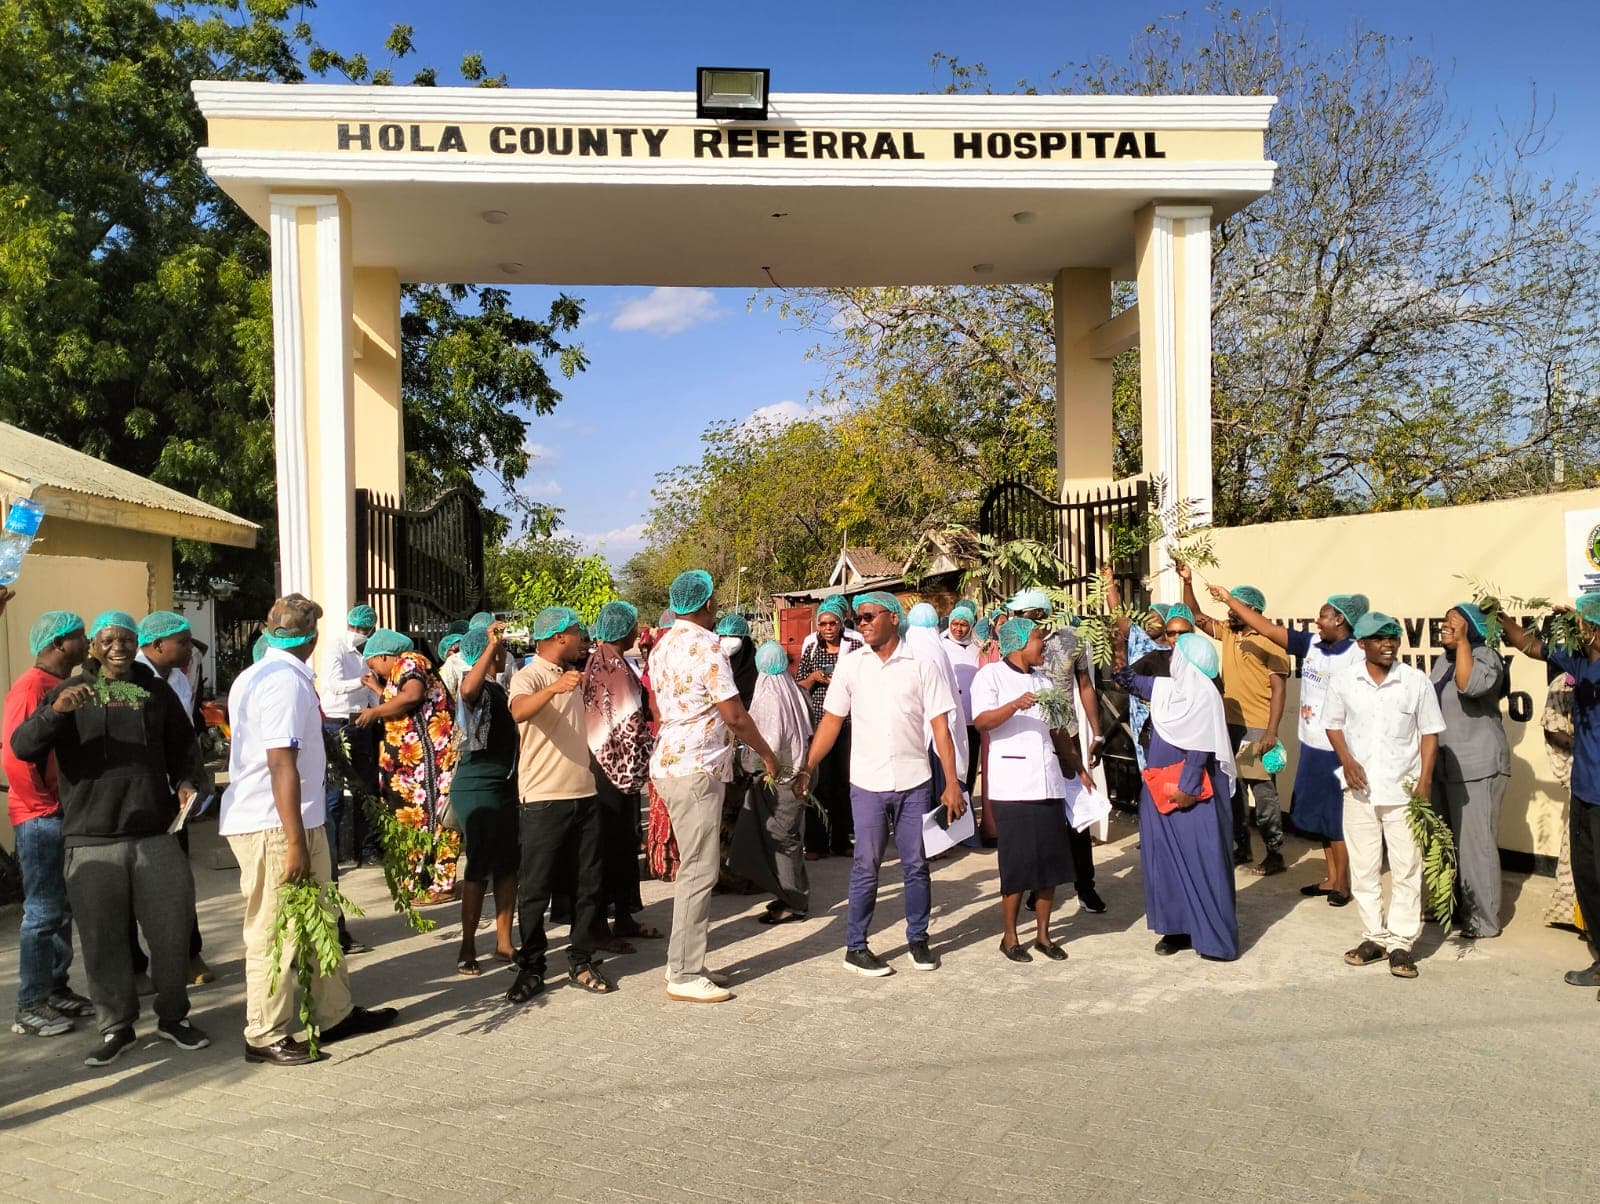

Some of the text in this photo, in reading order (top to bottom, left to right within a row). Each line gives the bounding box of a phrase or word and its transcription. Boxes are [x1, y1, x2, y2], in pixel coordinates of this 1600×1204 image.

[337, 123, 1166, 160] HOLA COUNTY REFERRAL HOSPITAL
